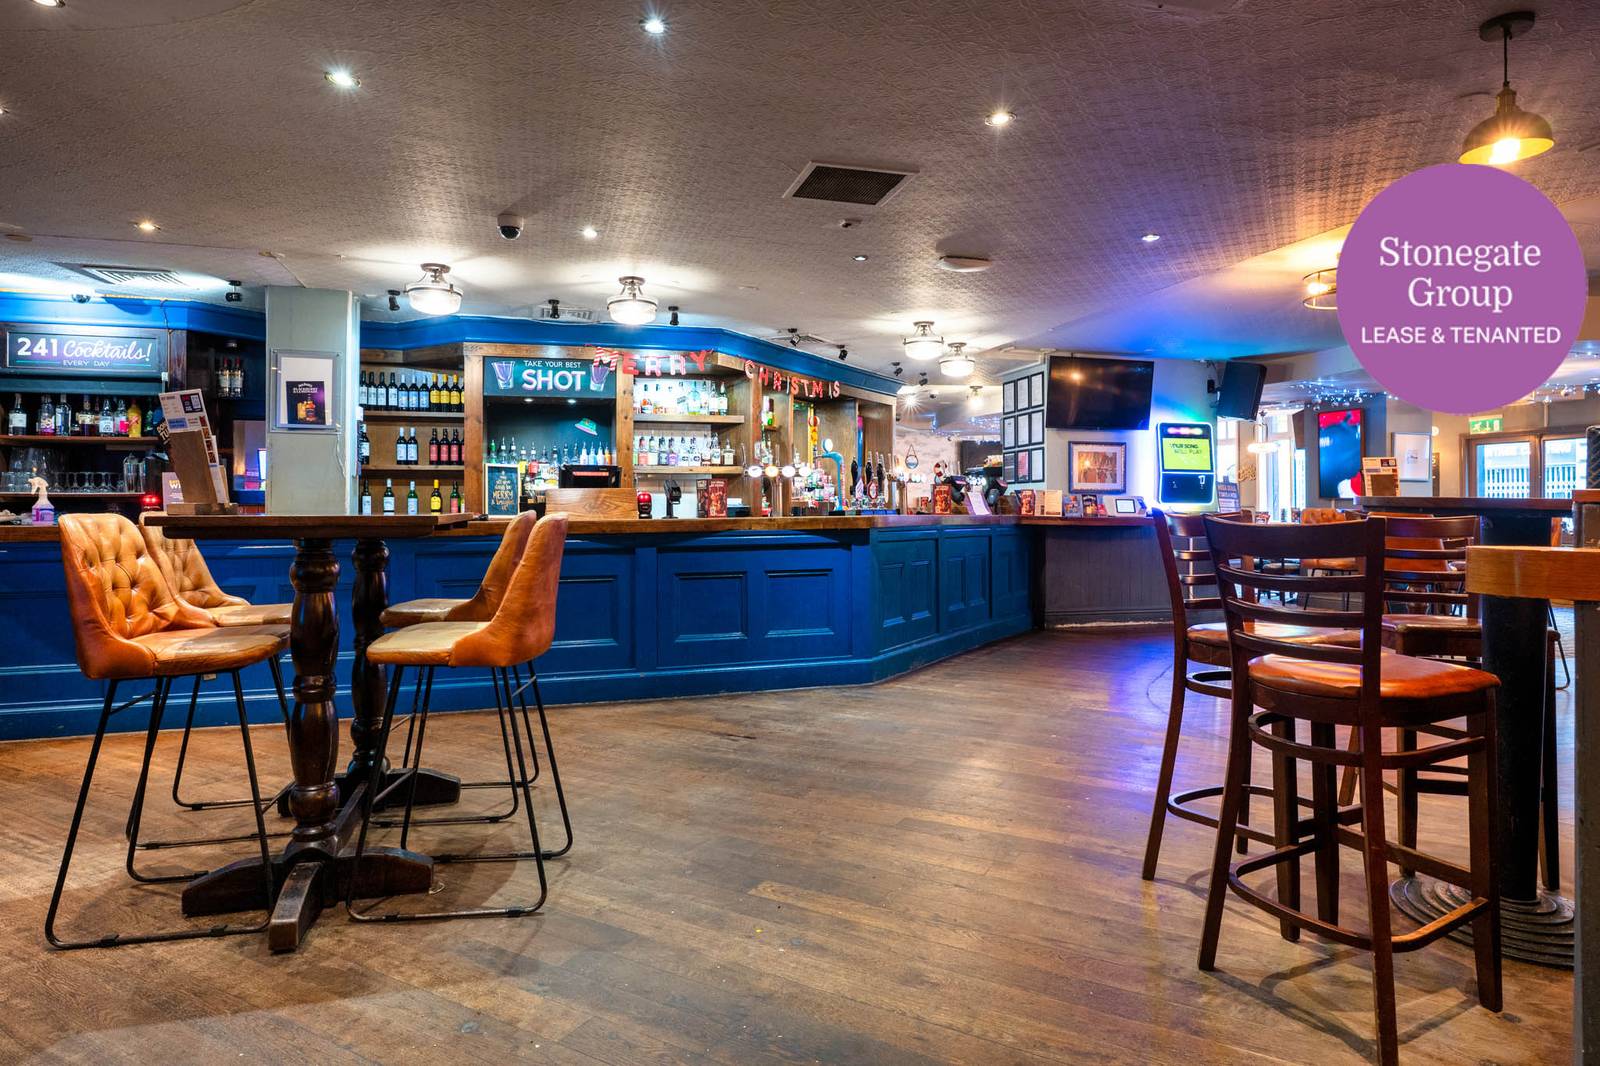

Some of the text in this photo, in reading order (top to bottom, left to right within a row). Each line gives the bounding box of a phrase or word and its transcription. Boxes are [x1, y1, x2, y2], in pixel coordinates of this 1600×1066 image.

[17, 337, 152, 362] 241 Cocktails!
[593, 346, 707, 377] MERRY
[524, 360, 542, 368] TAKE
[565, 361, 581, 369] BEST
[521, 368, 586, 392] SHOT
